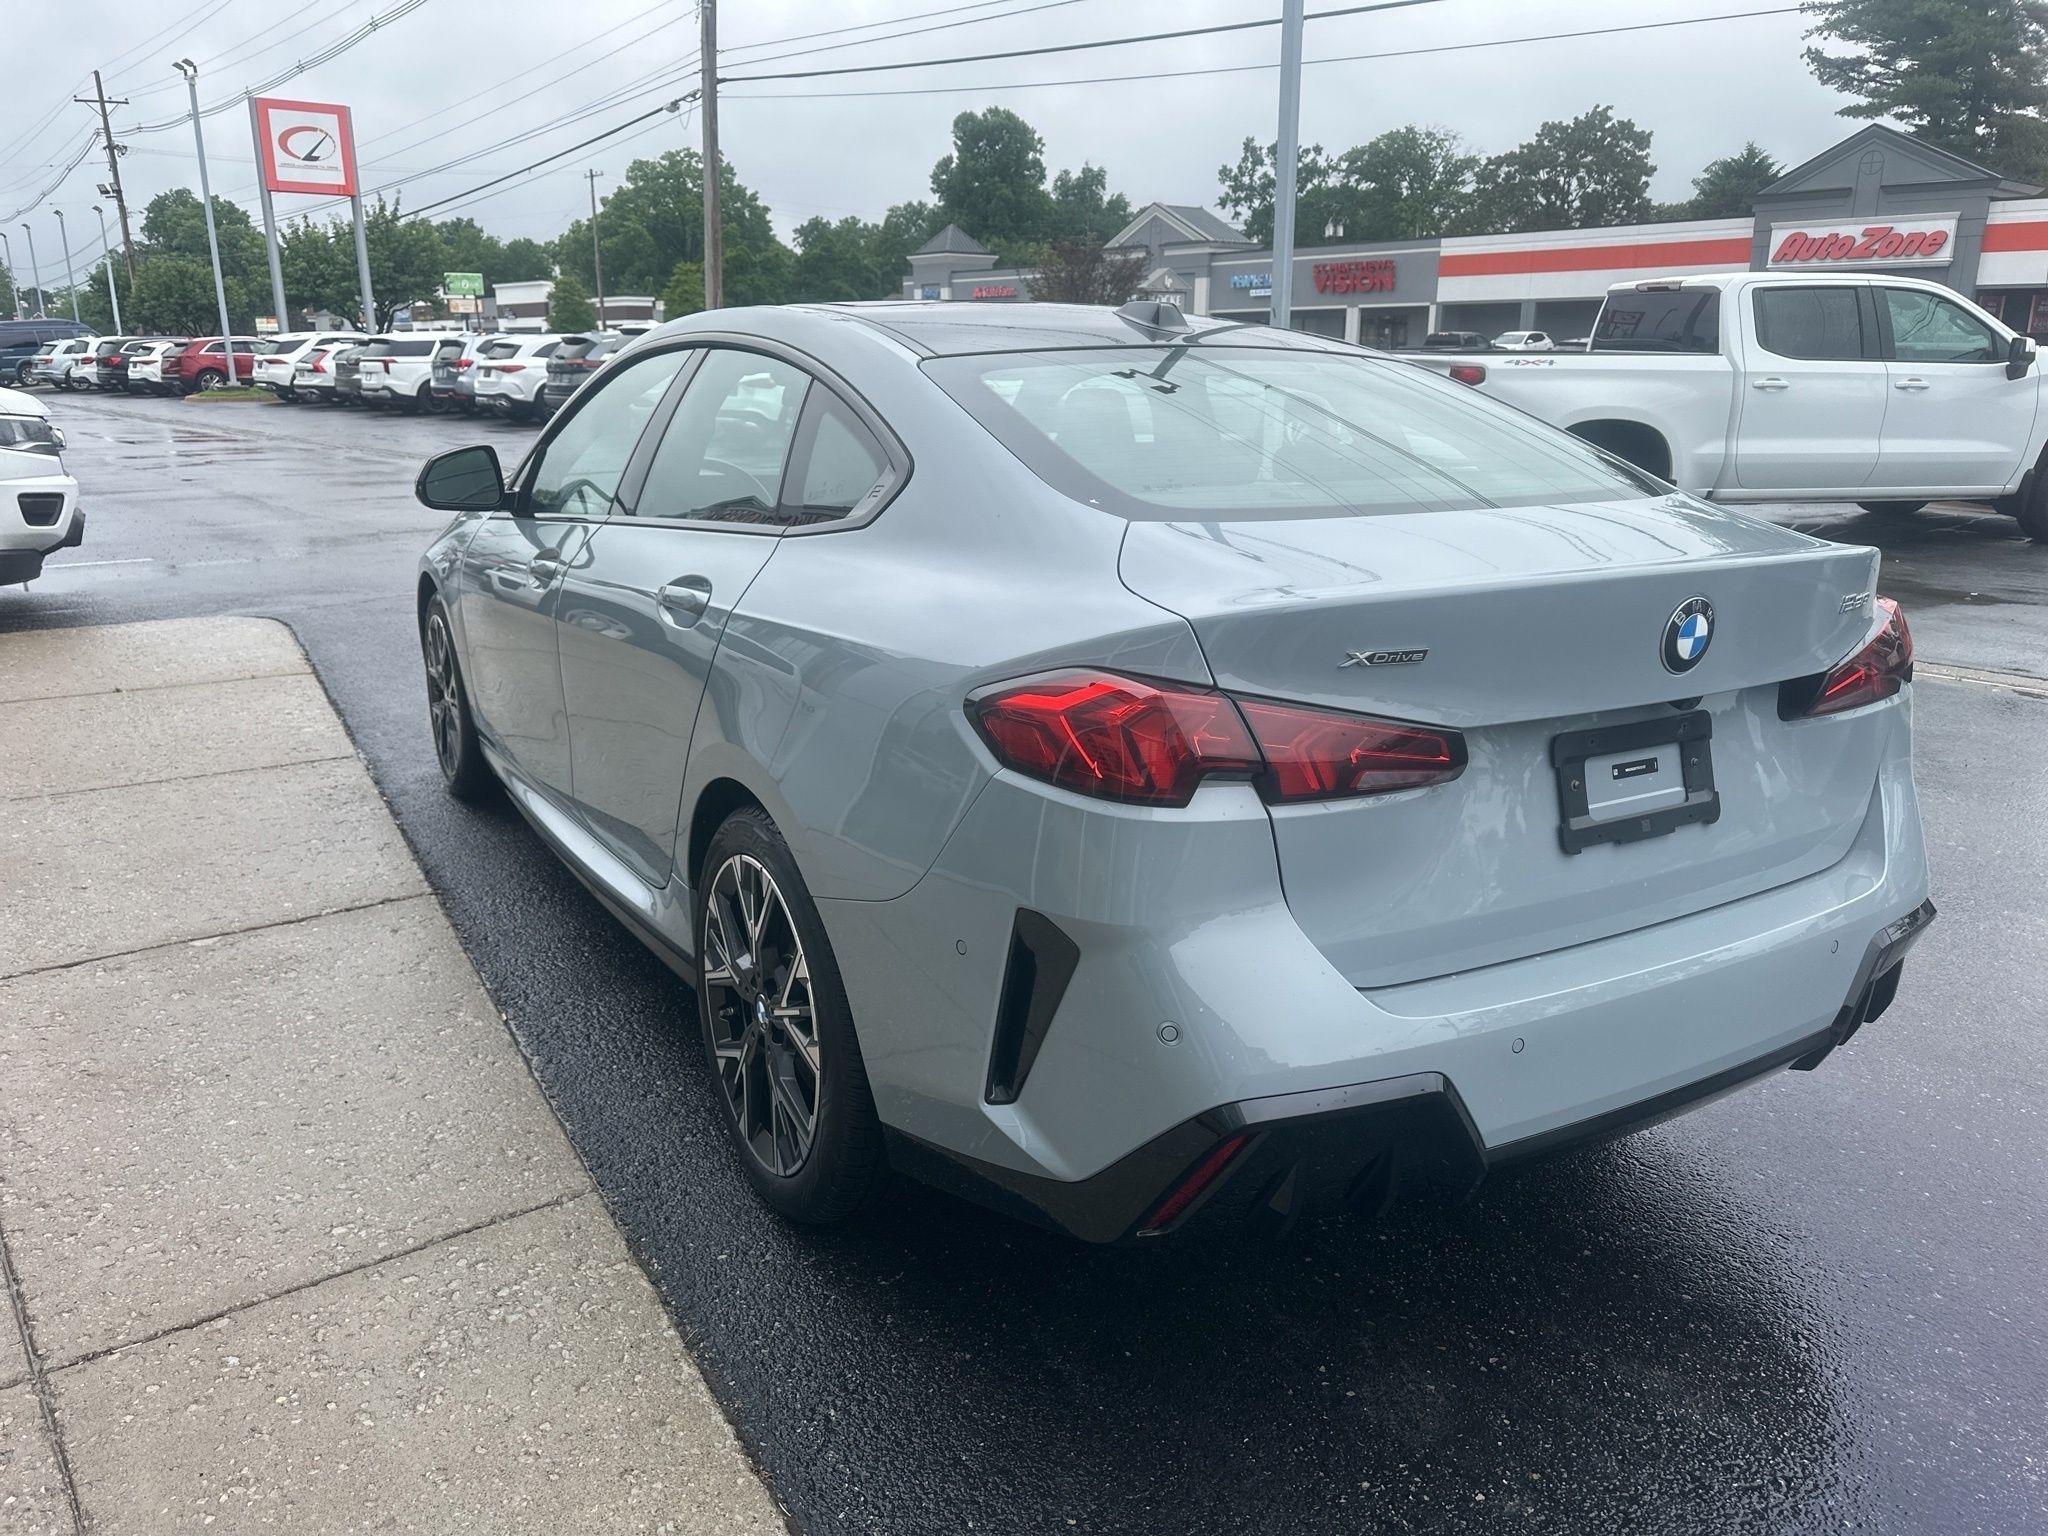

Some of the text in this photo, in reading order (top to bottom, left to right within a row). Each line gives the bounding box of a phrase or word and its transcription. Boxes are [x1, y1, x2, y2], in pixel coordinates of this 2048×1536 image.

[1772, 226, 1949, 262] AutoZone
[1314, 271, 1396, 294] VISION
[1674, 600, 1713, 626] BMW
